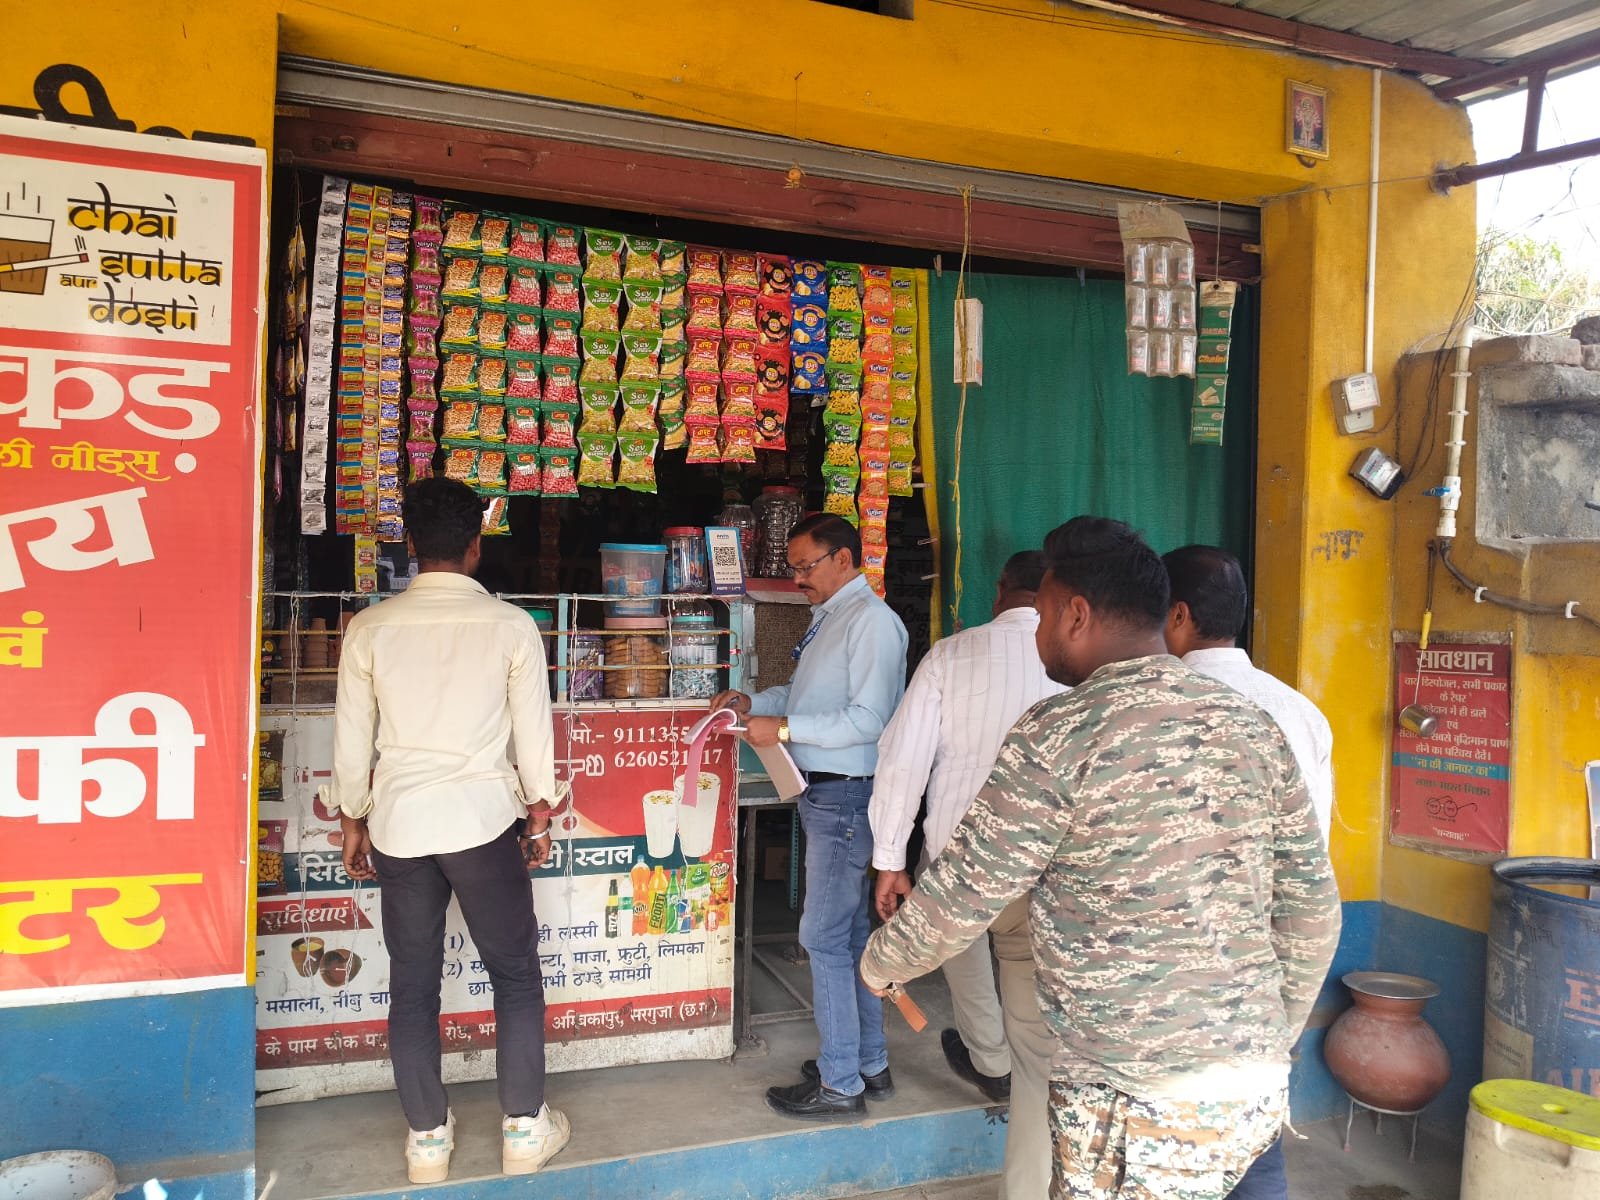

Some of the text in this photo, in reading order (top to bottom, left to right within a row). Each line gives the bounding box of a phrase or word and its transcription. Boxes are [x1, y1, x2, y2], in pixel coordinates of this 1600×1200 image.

[67, 182, 177, 239] chai
[98, 249, 222, 286] sutta
[88, 282, 198, 333] dosti
[1416, 650, 1494, 670] सावधान
[614, 749, 722, 767] 626052117
[574, 845, 635, 866] स्टाल
[658, 939, 705, 957] लिमका
[265, 997, 325, 1016] मसाला,
[288, 1039, 319, 1056] पास
[630, 1005, 674, 1025] सरगुजा
